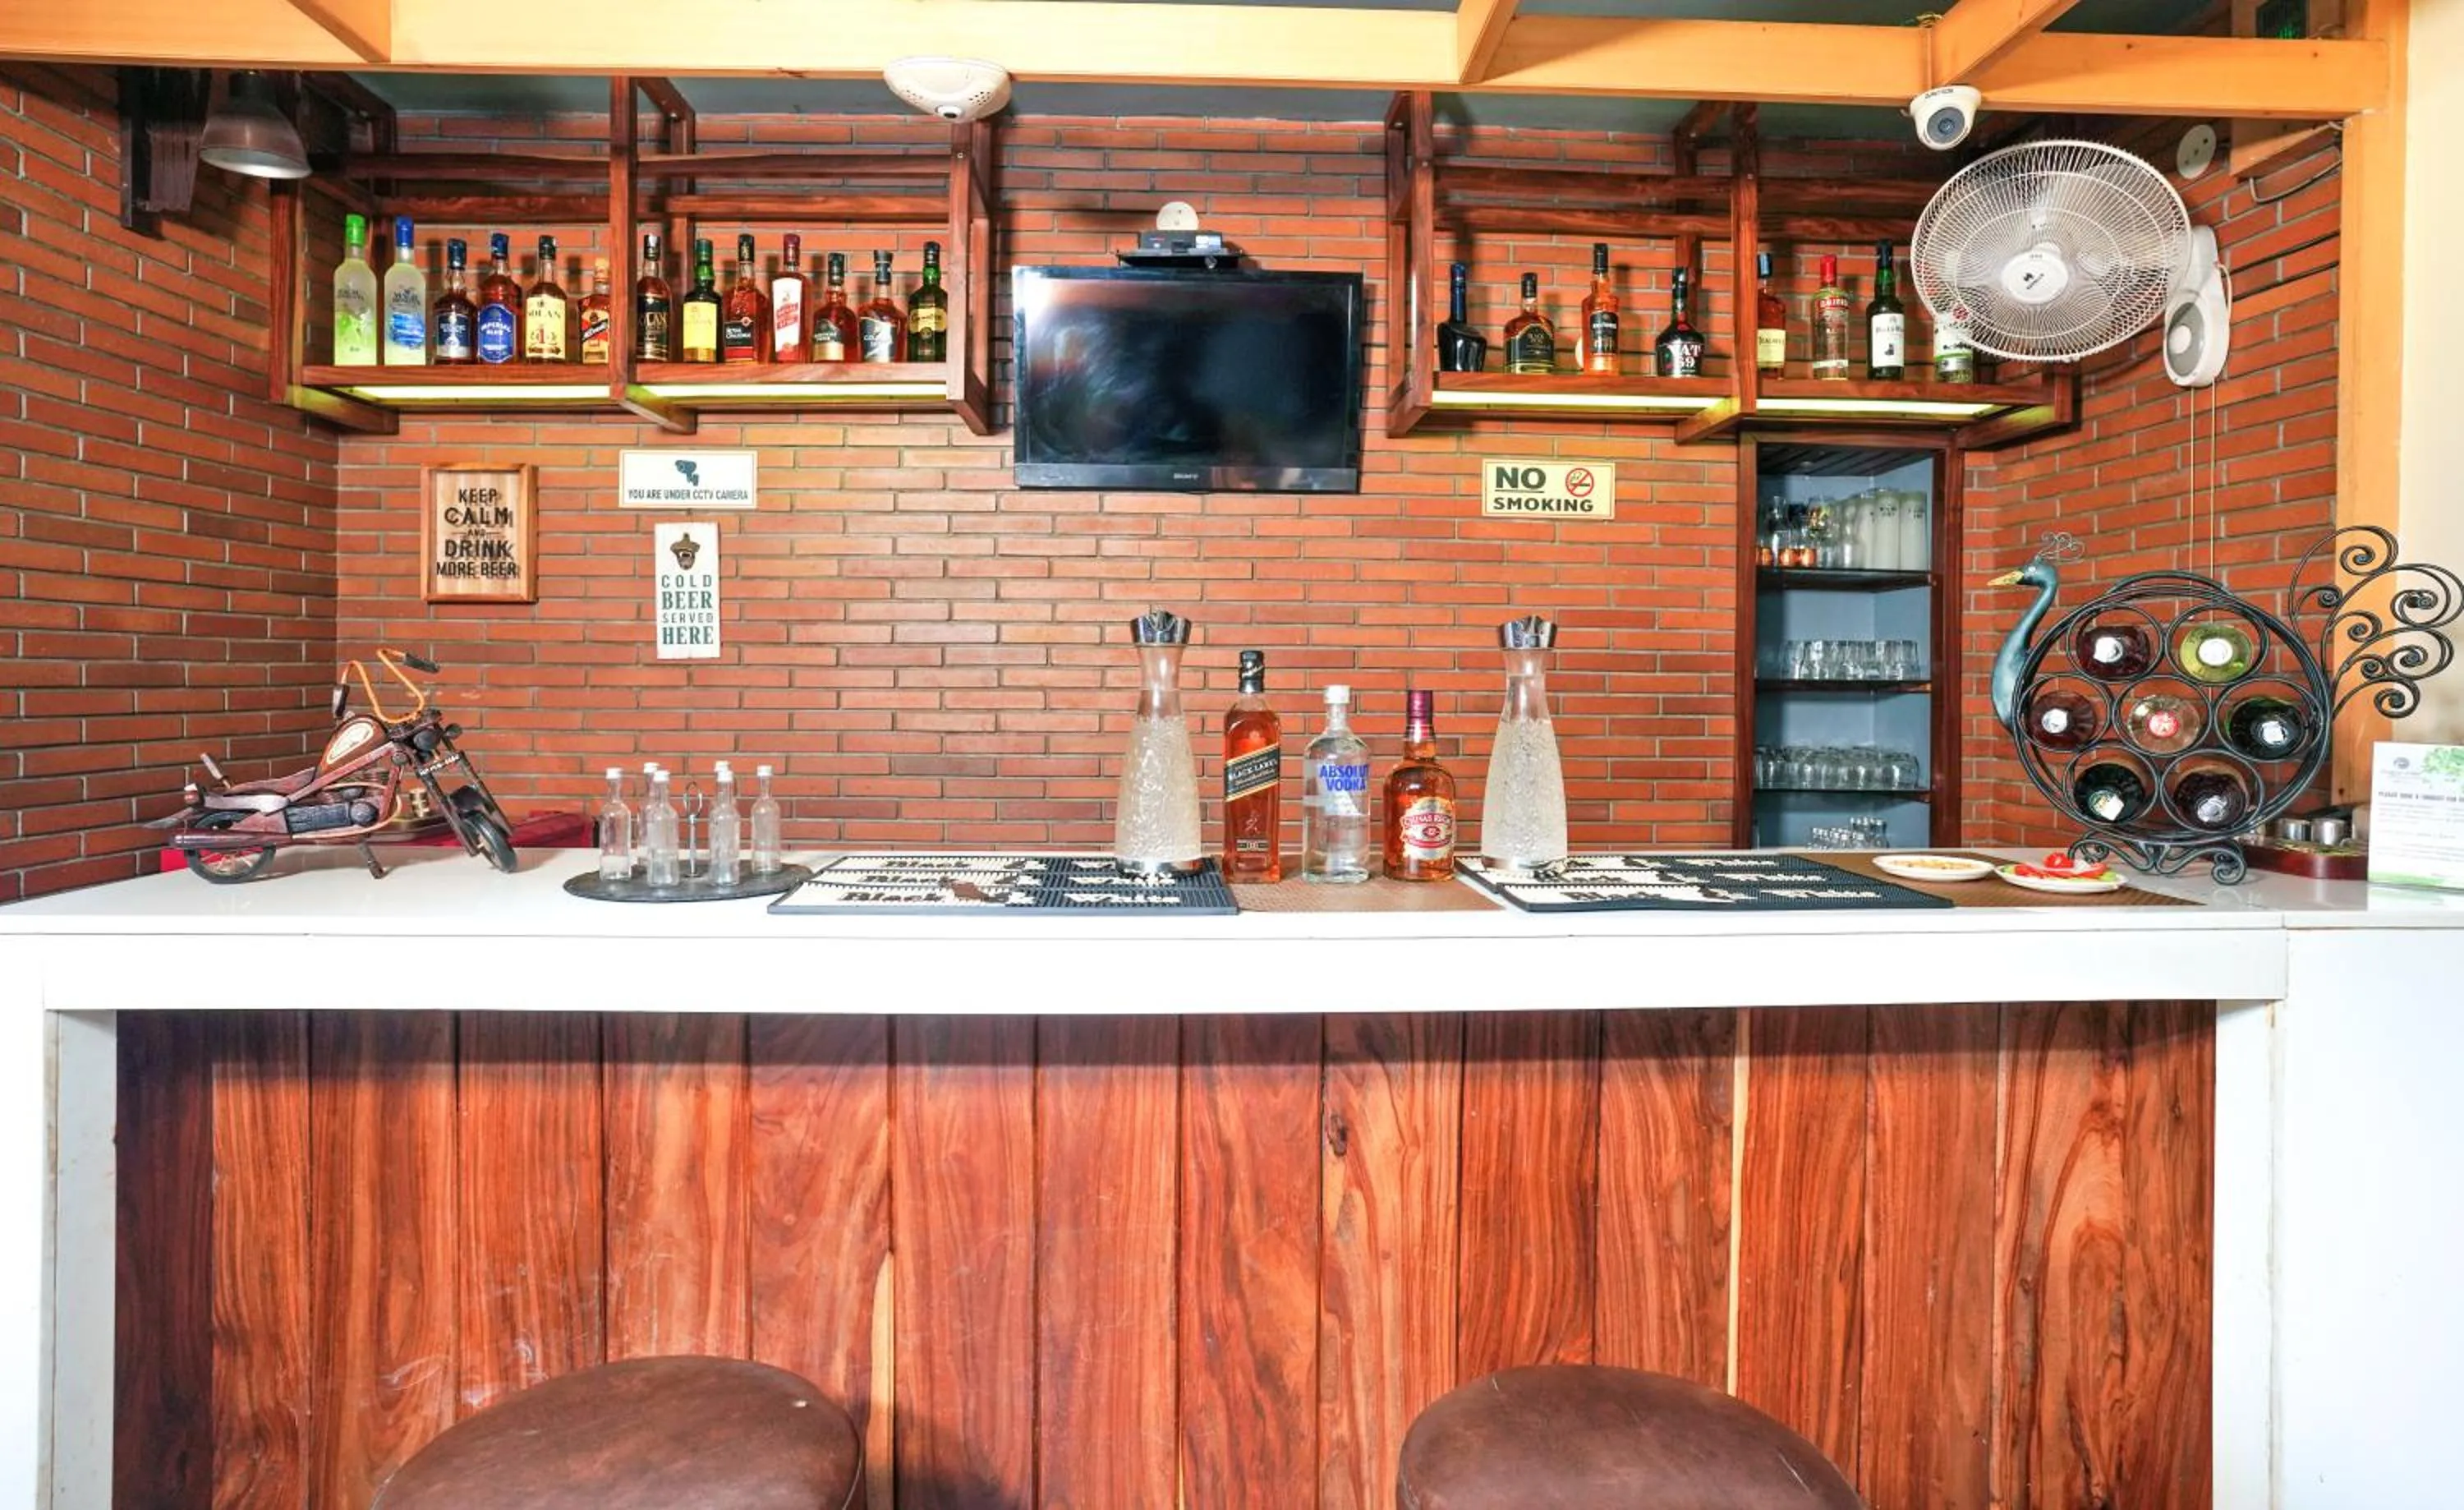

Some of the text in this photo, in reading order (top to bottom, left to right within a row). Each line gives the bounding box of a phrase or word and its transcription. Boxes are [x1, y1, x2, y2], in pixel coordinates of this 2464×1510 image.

[1496, 467, 1546, 490] NO
[458, 488, 498, 504] KEEP
[628, 490, 748, 499] YOU ARE UNDER CCTV CAMERA
[1493, 497, 1594, 512] SMOKING
[444, 507, 510, 525] CALM
[444, 540, 511, 558] DRINK
[436, 562, 517, 577] MORE BEER
[661, 574, 712, 588] COLD
[662, 591, 712, 609] BEER
[662, 612, 714, 624] SERVED
[662, 626, 714, 645] HERE
[1326, 778, 1366, 790] VODKA
[838, 891, 943, 901] Black
